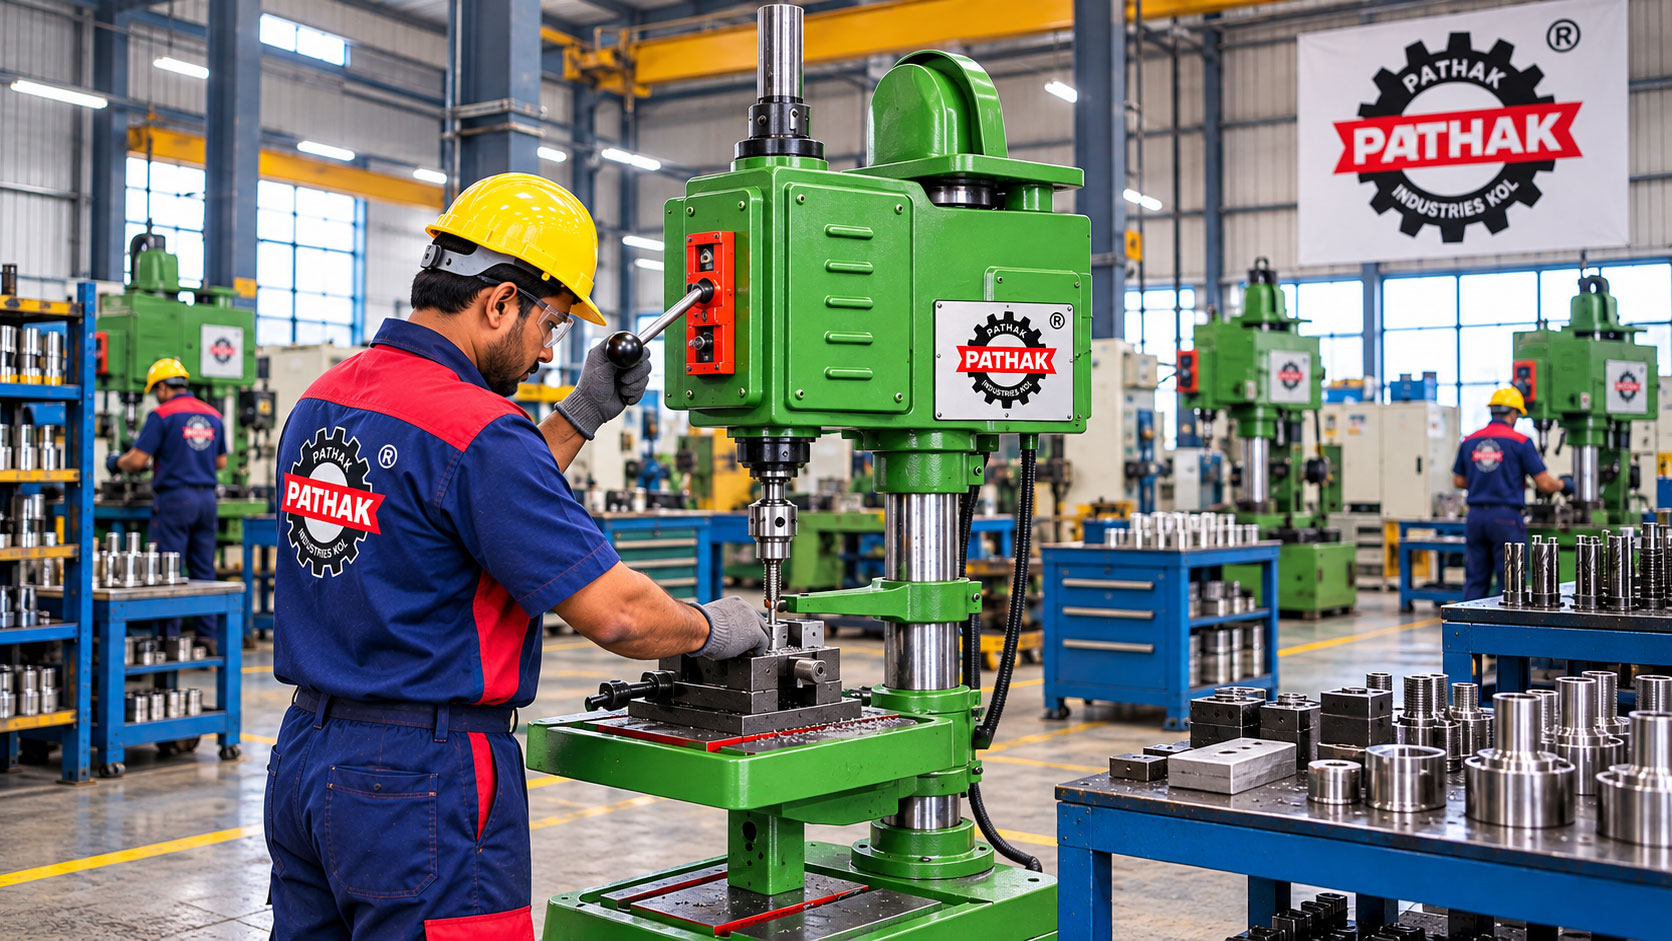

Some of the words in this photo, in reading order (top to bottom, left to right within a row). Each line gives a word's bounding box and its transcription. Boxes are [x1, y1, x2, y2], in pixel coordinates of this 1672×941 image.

[1402, 58, 1507, 93] PATHAK
[1353, 111, 1563, 165] PATHAK
[1391, 183, 1484, 218] INDUSTRIES
[1487, 179, 1519, 207] KOL
[986, 323, 1027, 338] PATHAK
[965, 350, 1049, 370] PATHAK
[312, 446, 352, 473] PATHAK
[286, 480, 374, 526] PATHAK
